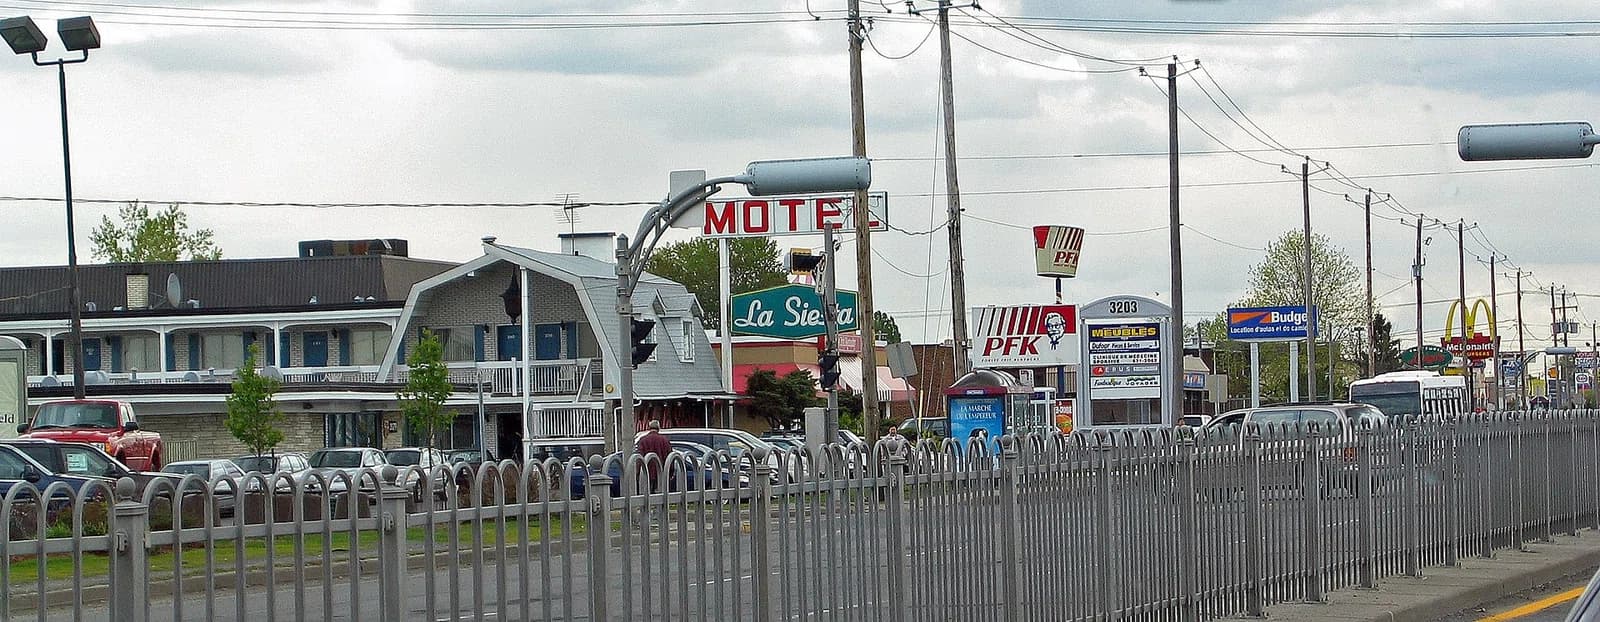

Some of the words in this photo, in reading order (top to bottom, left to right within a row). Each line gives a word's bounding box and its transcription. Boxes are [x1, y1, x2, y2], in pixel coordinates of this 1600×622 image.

[734, 299, 774, 327] La
[784, 296, 854, 327] Siea
[1109, 301, 1138, 313] 3203
[1271, 311, 1308, 325] Budge
[1091, 327, 1157, 337] MEUBLES
[982, 336, 1041, 356] PFK
